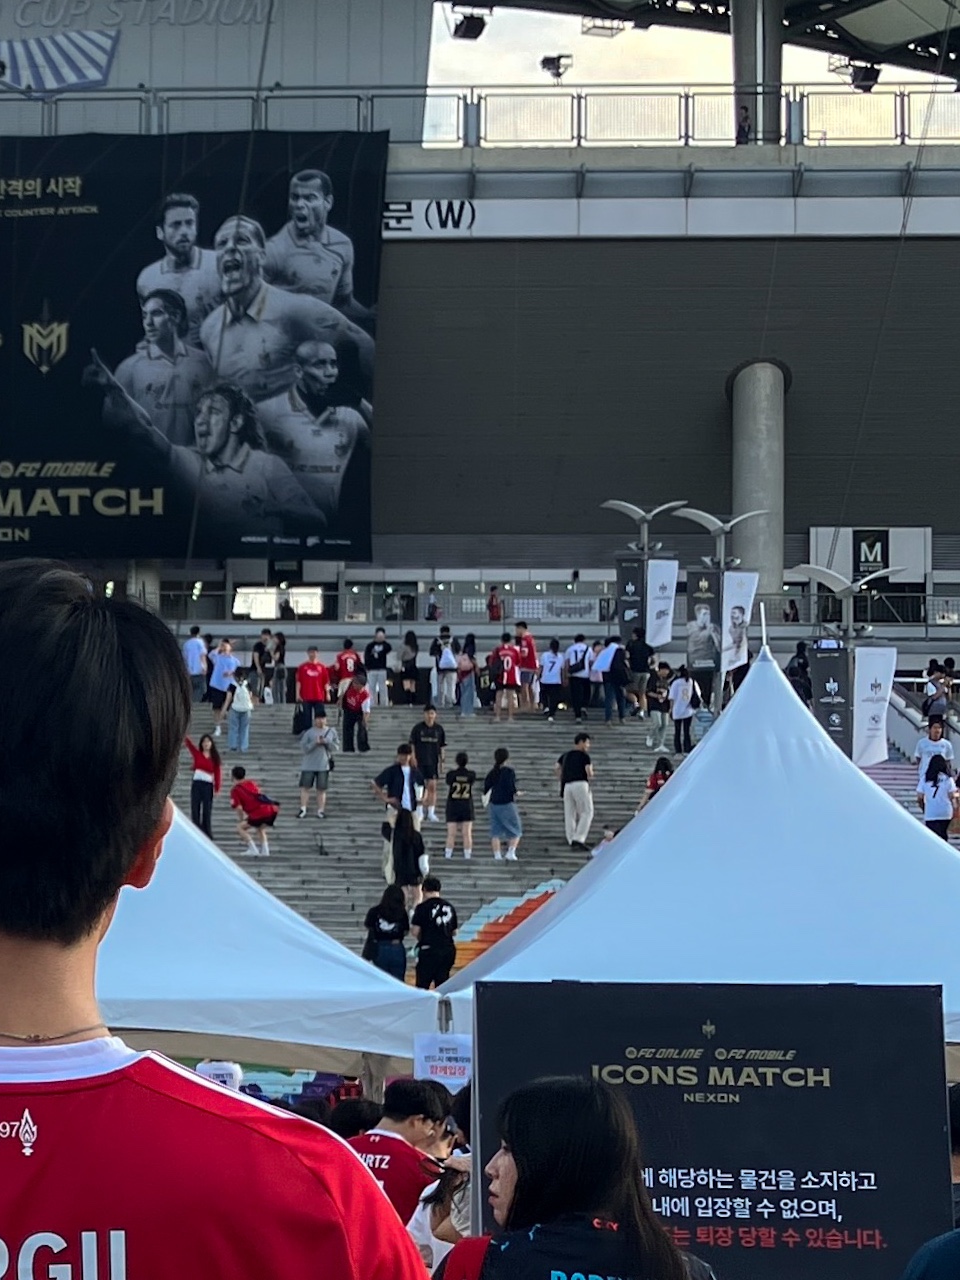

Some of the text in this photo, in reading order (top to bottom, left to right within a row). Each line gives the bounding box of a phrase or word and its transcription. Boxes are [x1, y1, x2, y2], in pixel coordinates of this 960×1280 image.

[14, 0, 87, 28] CUP
[101, 0, 275, 27] STADIUM
[47, 177, 82, 198] 시작
[39, 461, 116, 478] MOBILE
[861, 542, 882, 562] M
[452, 781, 471, 799] 22
[592, 1065, 831, 1087] ICONS MATCH
[683, 1092, 740, 1103] NEXON
[358, 1153, 391, 1170] IRTZ
[657, 1168, 734, 1188] 해당하는
[738, 1170, 796, 1190] 물건을
[800, 1171, 878, 1191] 소지하고
[652, 1197, 843, 1222] 내에 입장할 수 없으며,
[696, 1226, 733, 1246] 퇴장
[739, 1227, 776, 1247] 당할
[780, 1228, 801, 1247] 수
[806, 1228, 888, 1249] 있습니다.
